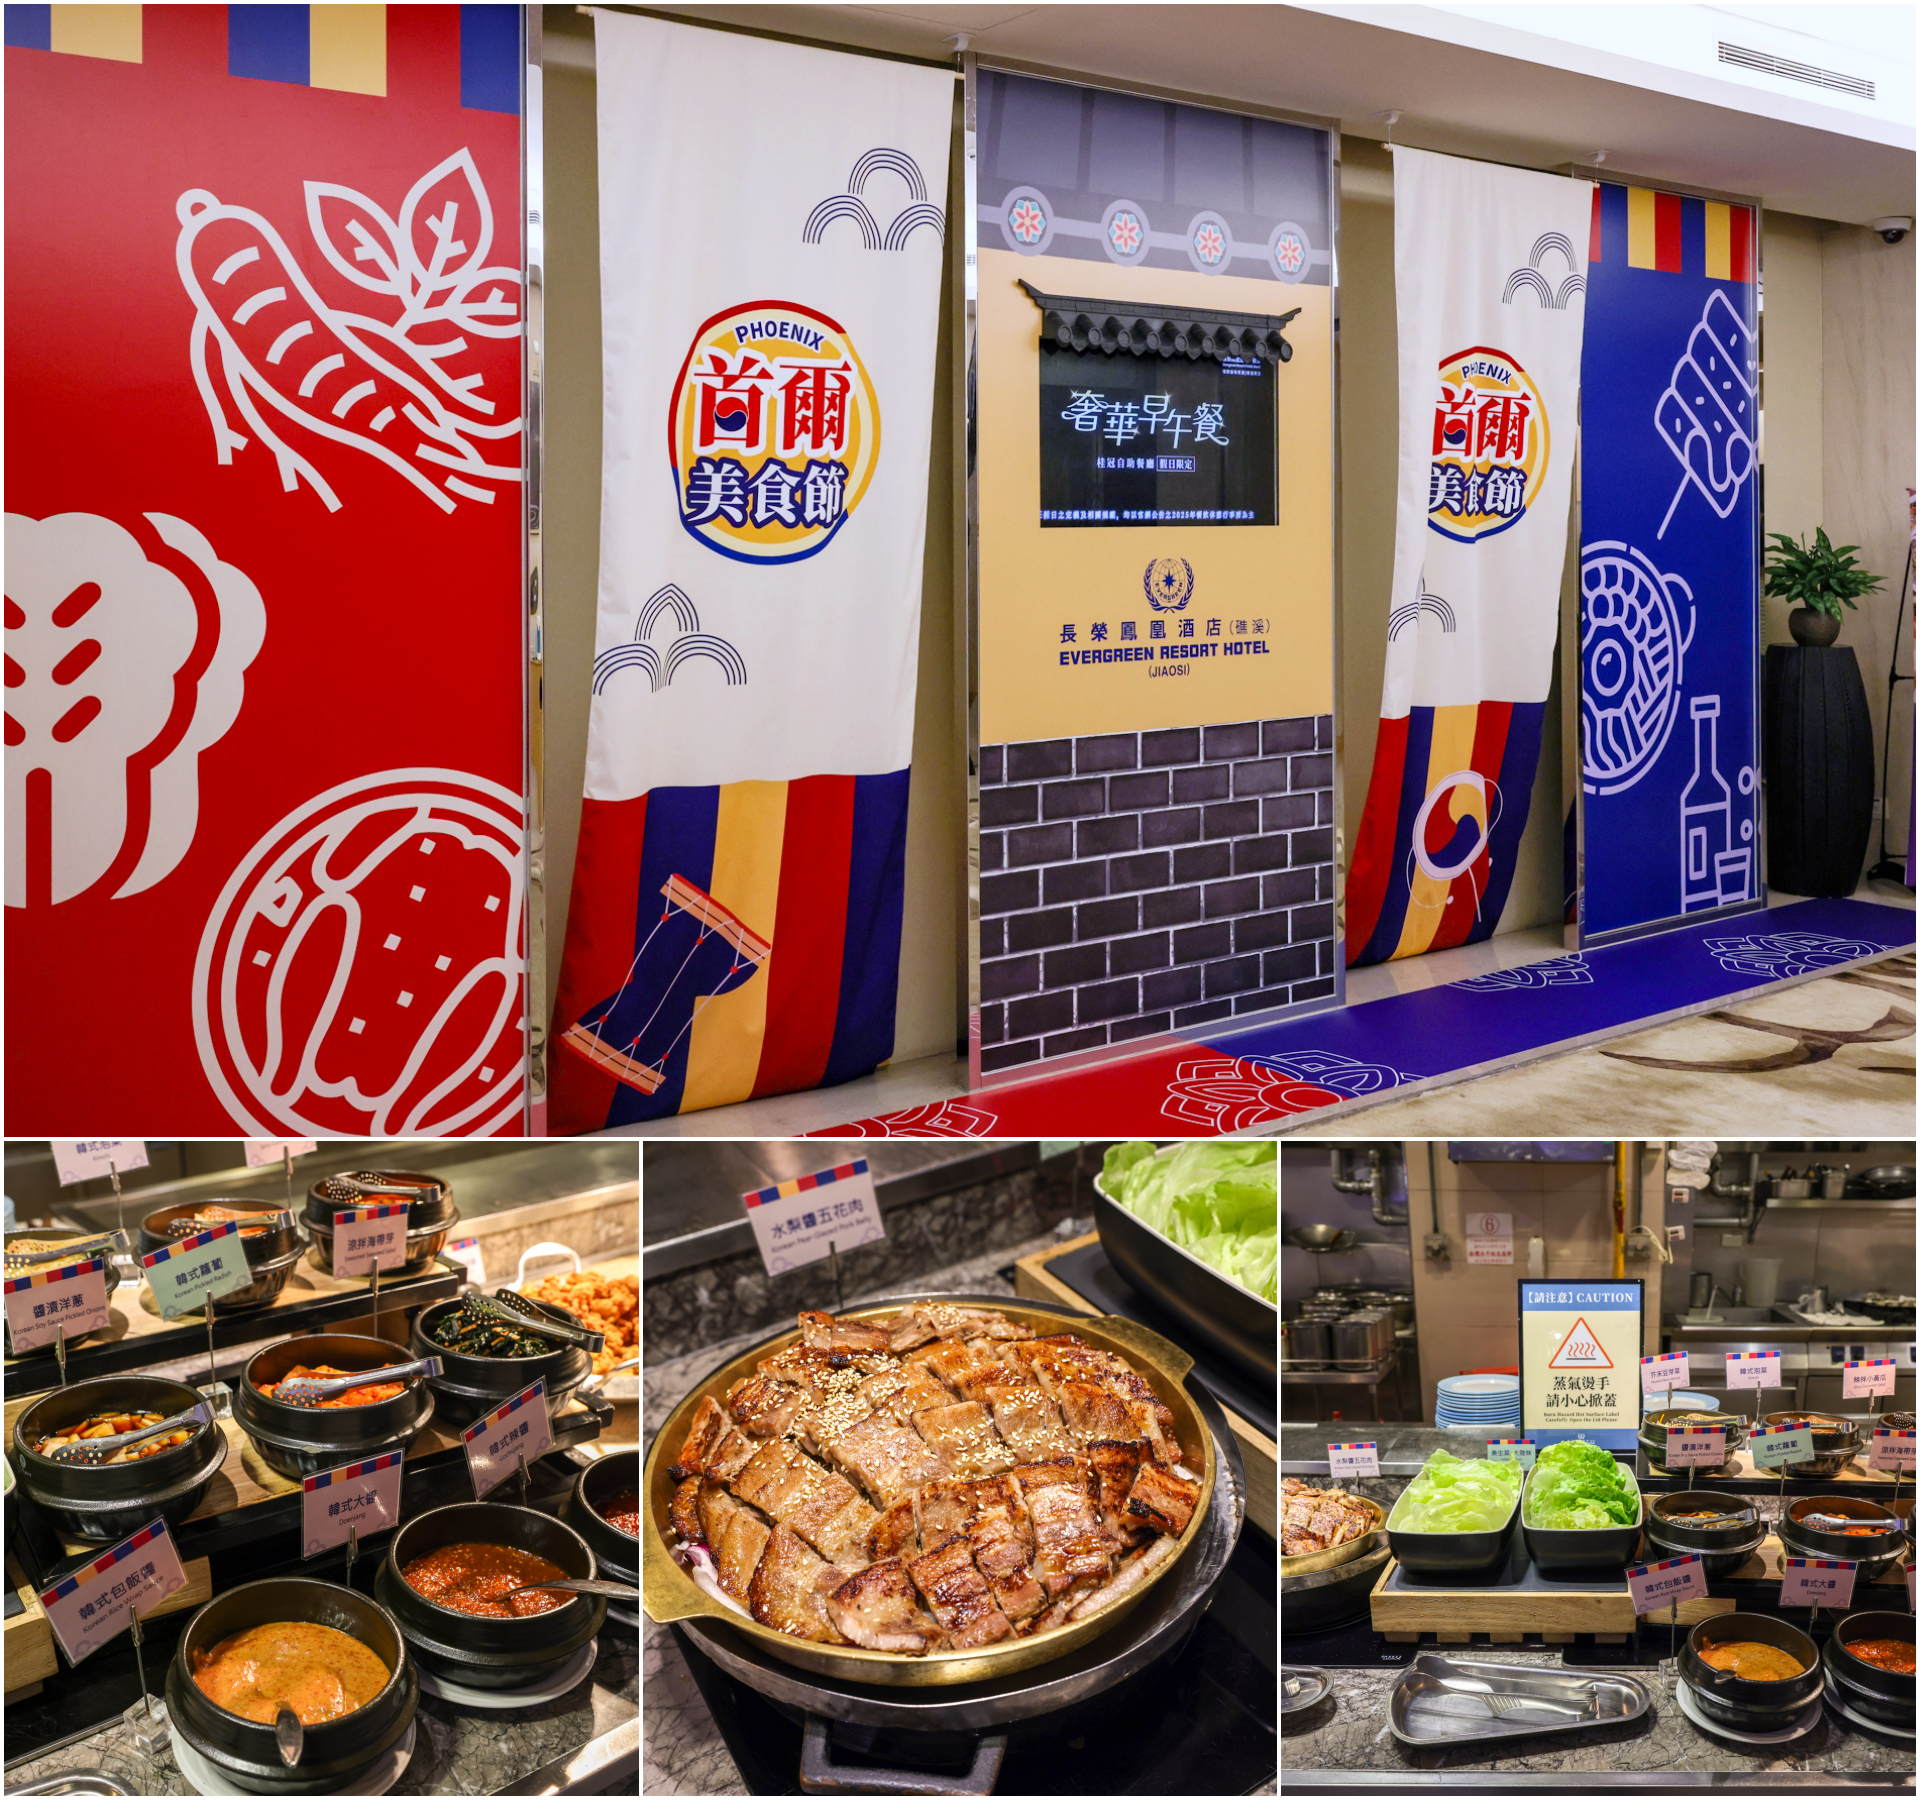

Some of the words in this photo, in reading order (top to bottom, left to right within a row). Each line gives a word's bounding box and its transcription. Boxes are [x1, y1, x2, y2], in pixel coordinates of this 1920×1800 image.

[735, 320, 825, 351] PHOENIX
[1462, 362, 1512, 384] PHOENIX
[693, 353, 853, 451] 首爾
[1061, 389, 1230, 449] 奢華早午餐
[1432, 386, 1532, 461] 首爾
[1097, 457, 1154, 469] 桂冠自助餐廳
[1159, 458, 1193, 470] 假日限定
[687, 461, 848, 525] 美食節
[1154, 581, 1184, 601] EVERGREEN
[1060, 618, 1222, 644] 長榮鳳凰酒店
[1060, 646, 1154, 666] EVERGREEN
[1160, 643, 1218, 660] RESORT
[1223, 640, 1270, 656] HOTEL
[1148, 663, 1191, 679] (JIAOSI)
[771, 1198, 864, 1239] 水梨醬五花肉
[1485, 1216, 1495, 1232] 6
[174, 1287, 194, 1299] Korean
[194, 1278, 213, 1290] Pickled
[213, 1270, 232, 1281] Radish
[175, 1257, 223, 1286] 韓式蘿蔔
[33, 1293, 84, 1319] 醬漬洋蔥
[1576, 1292, 1634, 1303] CAUTION
[13, 1325, 35, 1336] Korean
[35, 1322, 46, 1330] Soy
[47, 1317, 64, 1326] Sauce
[65, 1310, 85, 1320] Pickled
[86, 1305, 106, 1315] Onions
[1552, 1376, 1610, 1391] 蒸氣燙手
[1739, 1367, 1767, 1375] 韓式泡菜
[1546, 1393, 1617, 1408] 請小心掀蓋
[489, 1421, 529, 1456] 韓式辣醬
[1766, 1440, 1798, 1452] 韓式蘿蔔
[339, 1512, 366, 1526] Doenjang
[78, 1561, 156, 1620] 韓式包飯醬
[1645, 1574, 1691, 1593] 韓式包飯醬
[1800, 1579, 1836, 1589] 韓式大醬
[82, 1613, 108, 1633] Korean
[108, 1603, 124, 1616] Rice
[123, 1591, 144, 1605] Wrap
[143, 1575, 164, 1592] Sauce
